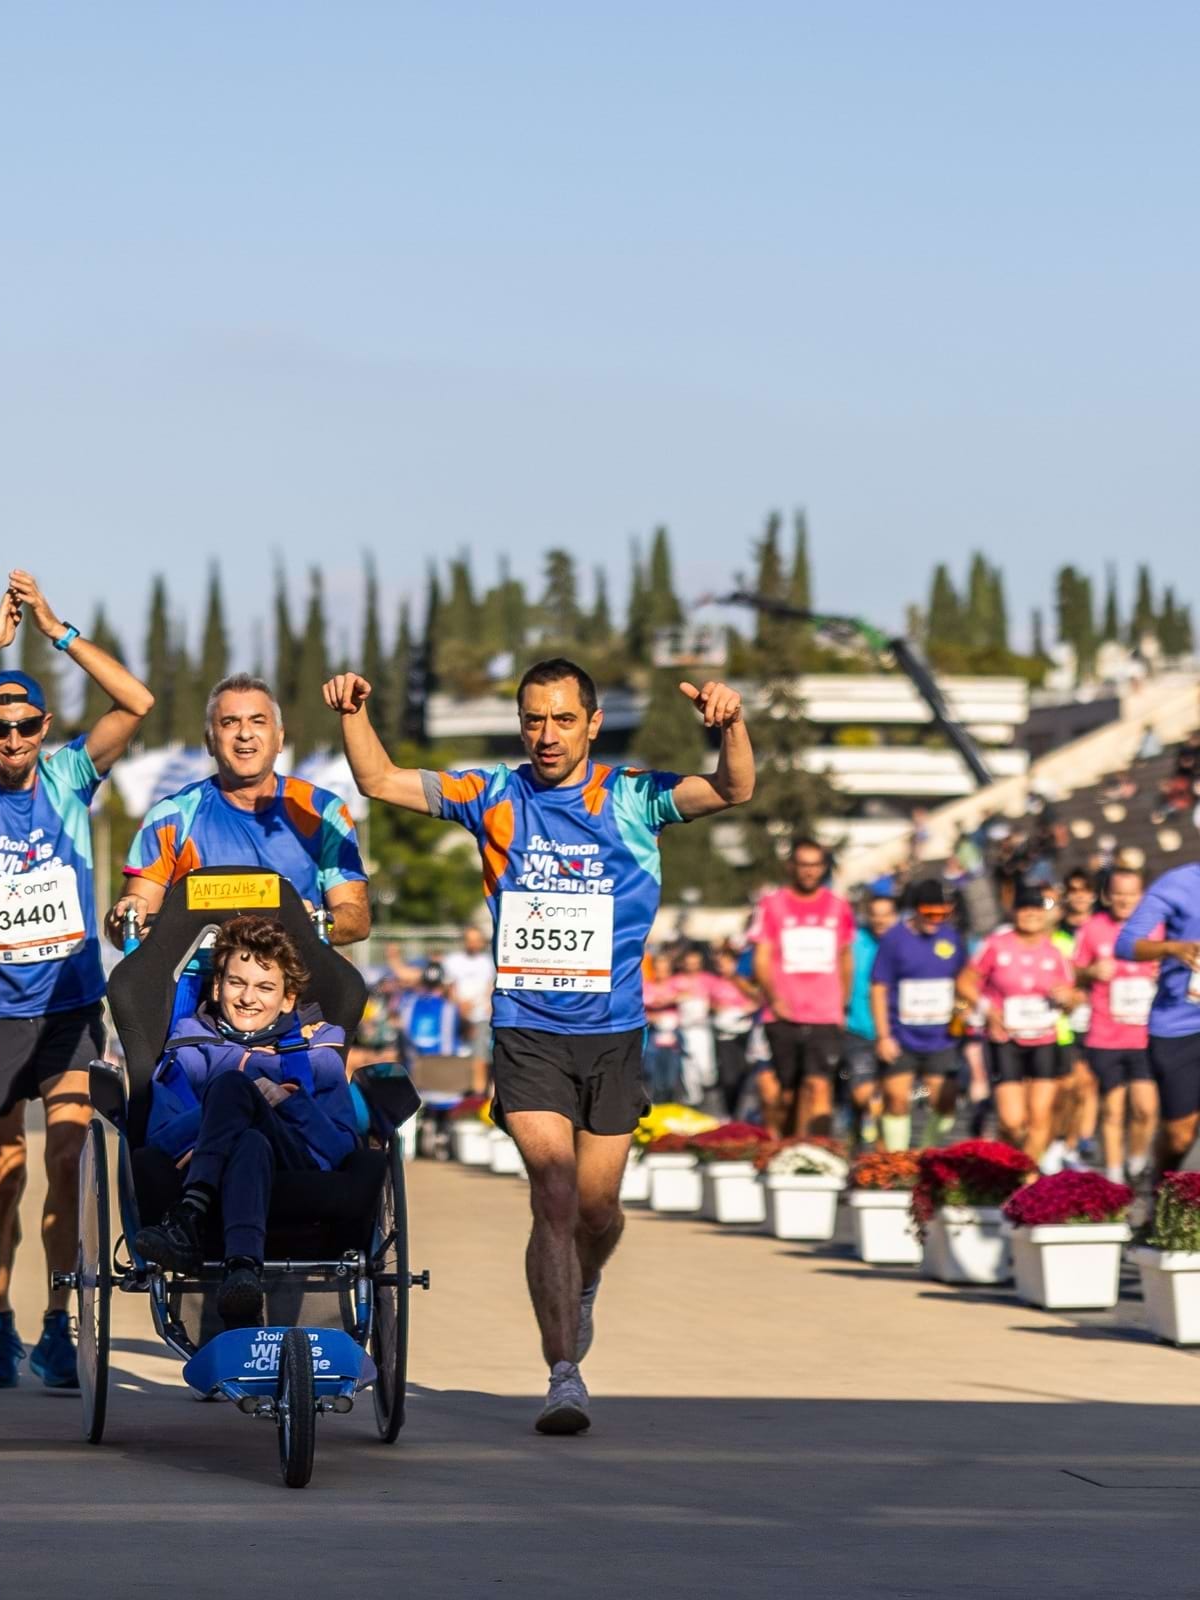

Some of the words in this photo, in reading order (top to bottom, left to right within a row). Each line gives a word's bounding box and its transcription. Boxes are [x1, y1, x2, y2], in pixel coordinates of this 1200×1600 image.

[527, 834, 600, 857] Stoiximan
[516, 874, 527, 886] of
[526, 871, 614, 894] Change
[515, 927, 595, 952] 35537
[244, 1361, 256, 1370] of
